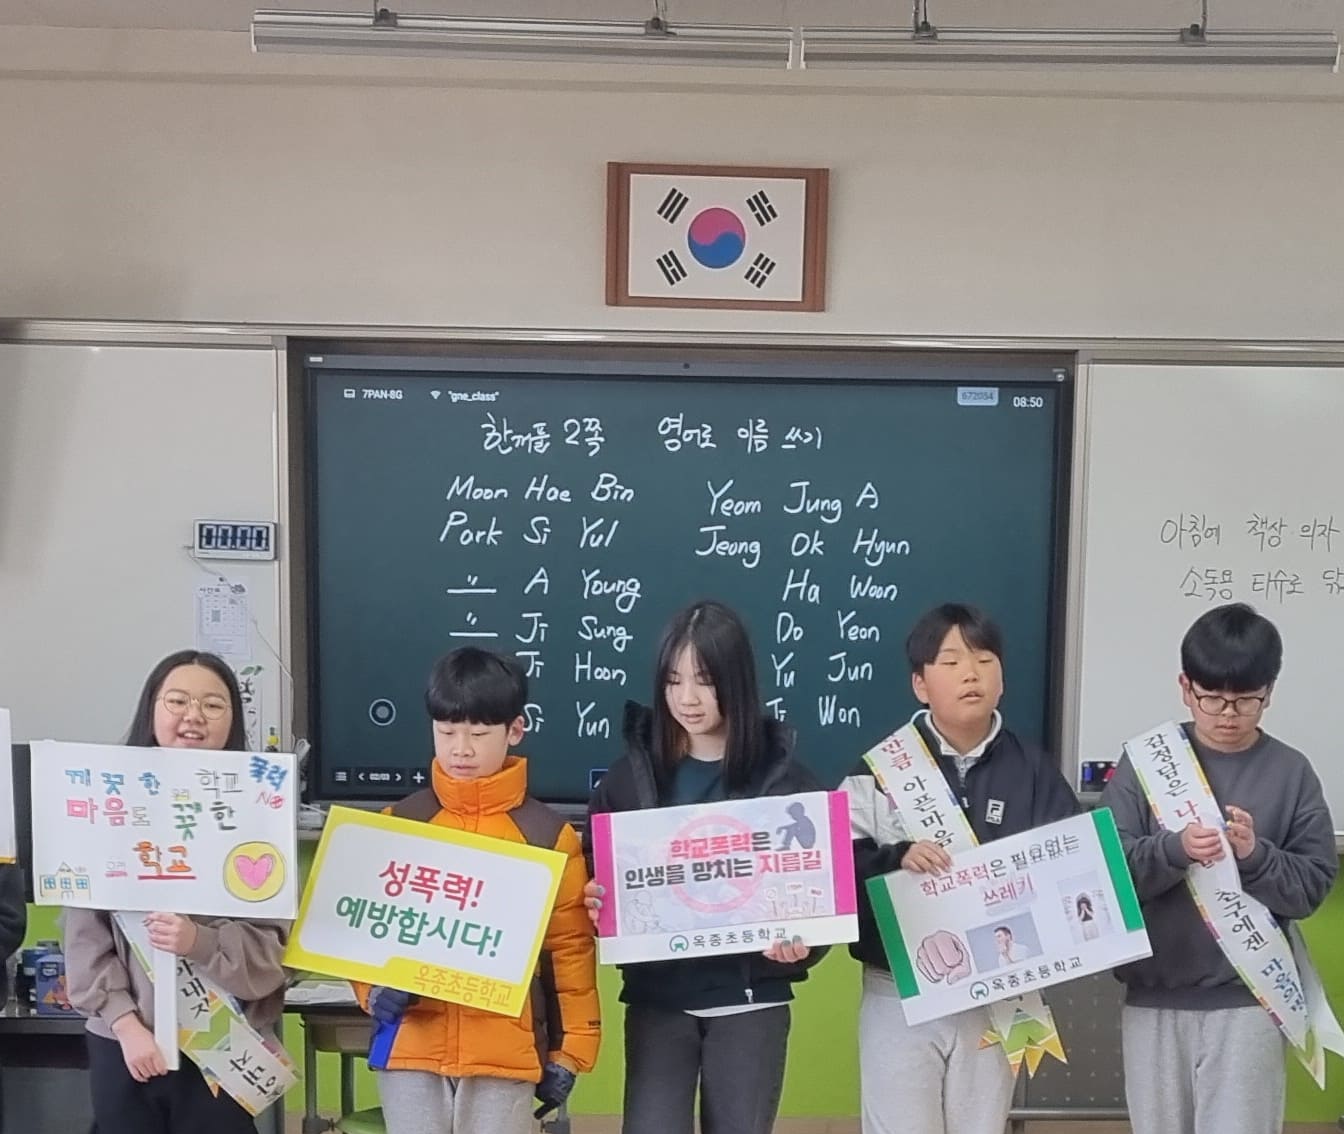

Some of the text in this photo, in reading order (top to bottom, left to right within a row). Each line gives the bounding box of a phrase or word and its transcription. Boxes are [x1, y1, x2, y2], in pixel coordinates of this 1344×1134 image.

[1013, 396, 1044, 408] 08:50
[658, 413, 717, 452] 영어로
[737, 418, 769, 454] 이름
[782, 426, 823, 450] 쓰기
[446, 475, 508, 502] Moon
[591, 473, 635, 502] Bin
[707, 479, 880, 524] Yeom Jung A
[523, 516, 551, 545] Si
[579, 516, 619, 549] Yul
[695, 526, 910, 568] Jeong Ok Hyun
[1160, 513, 1341, 552] 아침에 책상 의자
[524, 566, 549, 595] A
[581, 568, 641, 613] Young
[782, 569, 898, 604] Ha Woon
[1180, 566, 1233, 601] 소독용
[1252, 569, 1304, 604] 티슈로
[515, 612, 549, 644] Ji
[578, 616, 633, 652] Sung
[776, 611, 880, 644] Do Yeon
[575, 652, 627, 686] Hoon
[771, 653, 873, 688] Yu Jun
[576, 701, 610, 738] Yun
[818, 696, 861, 728] Won
[66, 797, 151, 828] 마음도
[132, 841, 192, 876] 학교
[670, 831, 771, 860] 학교폭력은
[378, 860, 484, 911] 성폭력!
[625, 850, 822, 890] 인생을 망치는 지름길
[920, 858, 1007, 898] 학교폭력은
[336, 896, 503, 957] 예방합시다!
[692, 928, 787, 948] 옥종초등학교
[413, 965, 513, 1007] 옥종초등학교
[992, 956, 1083, 992] 옥종초등학교
